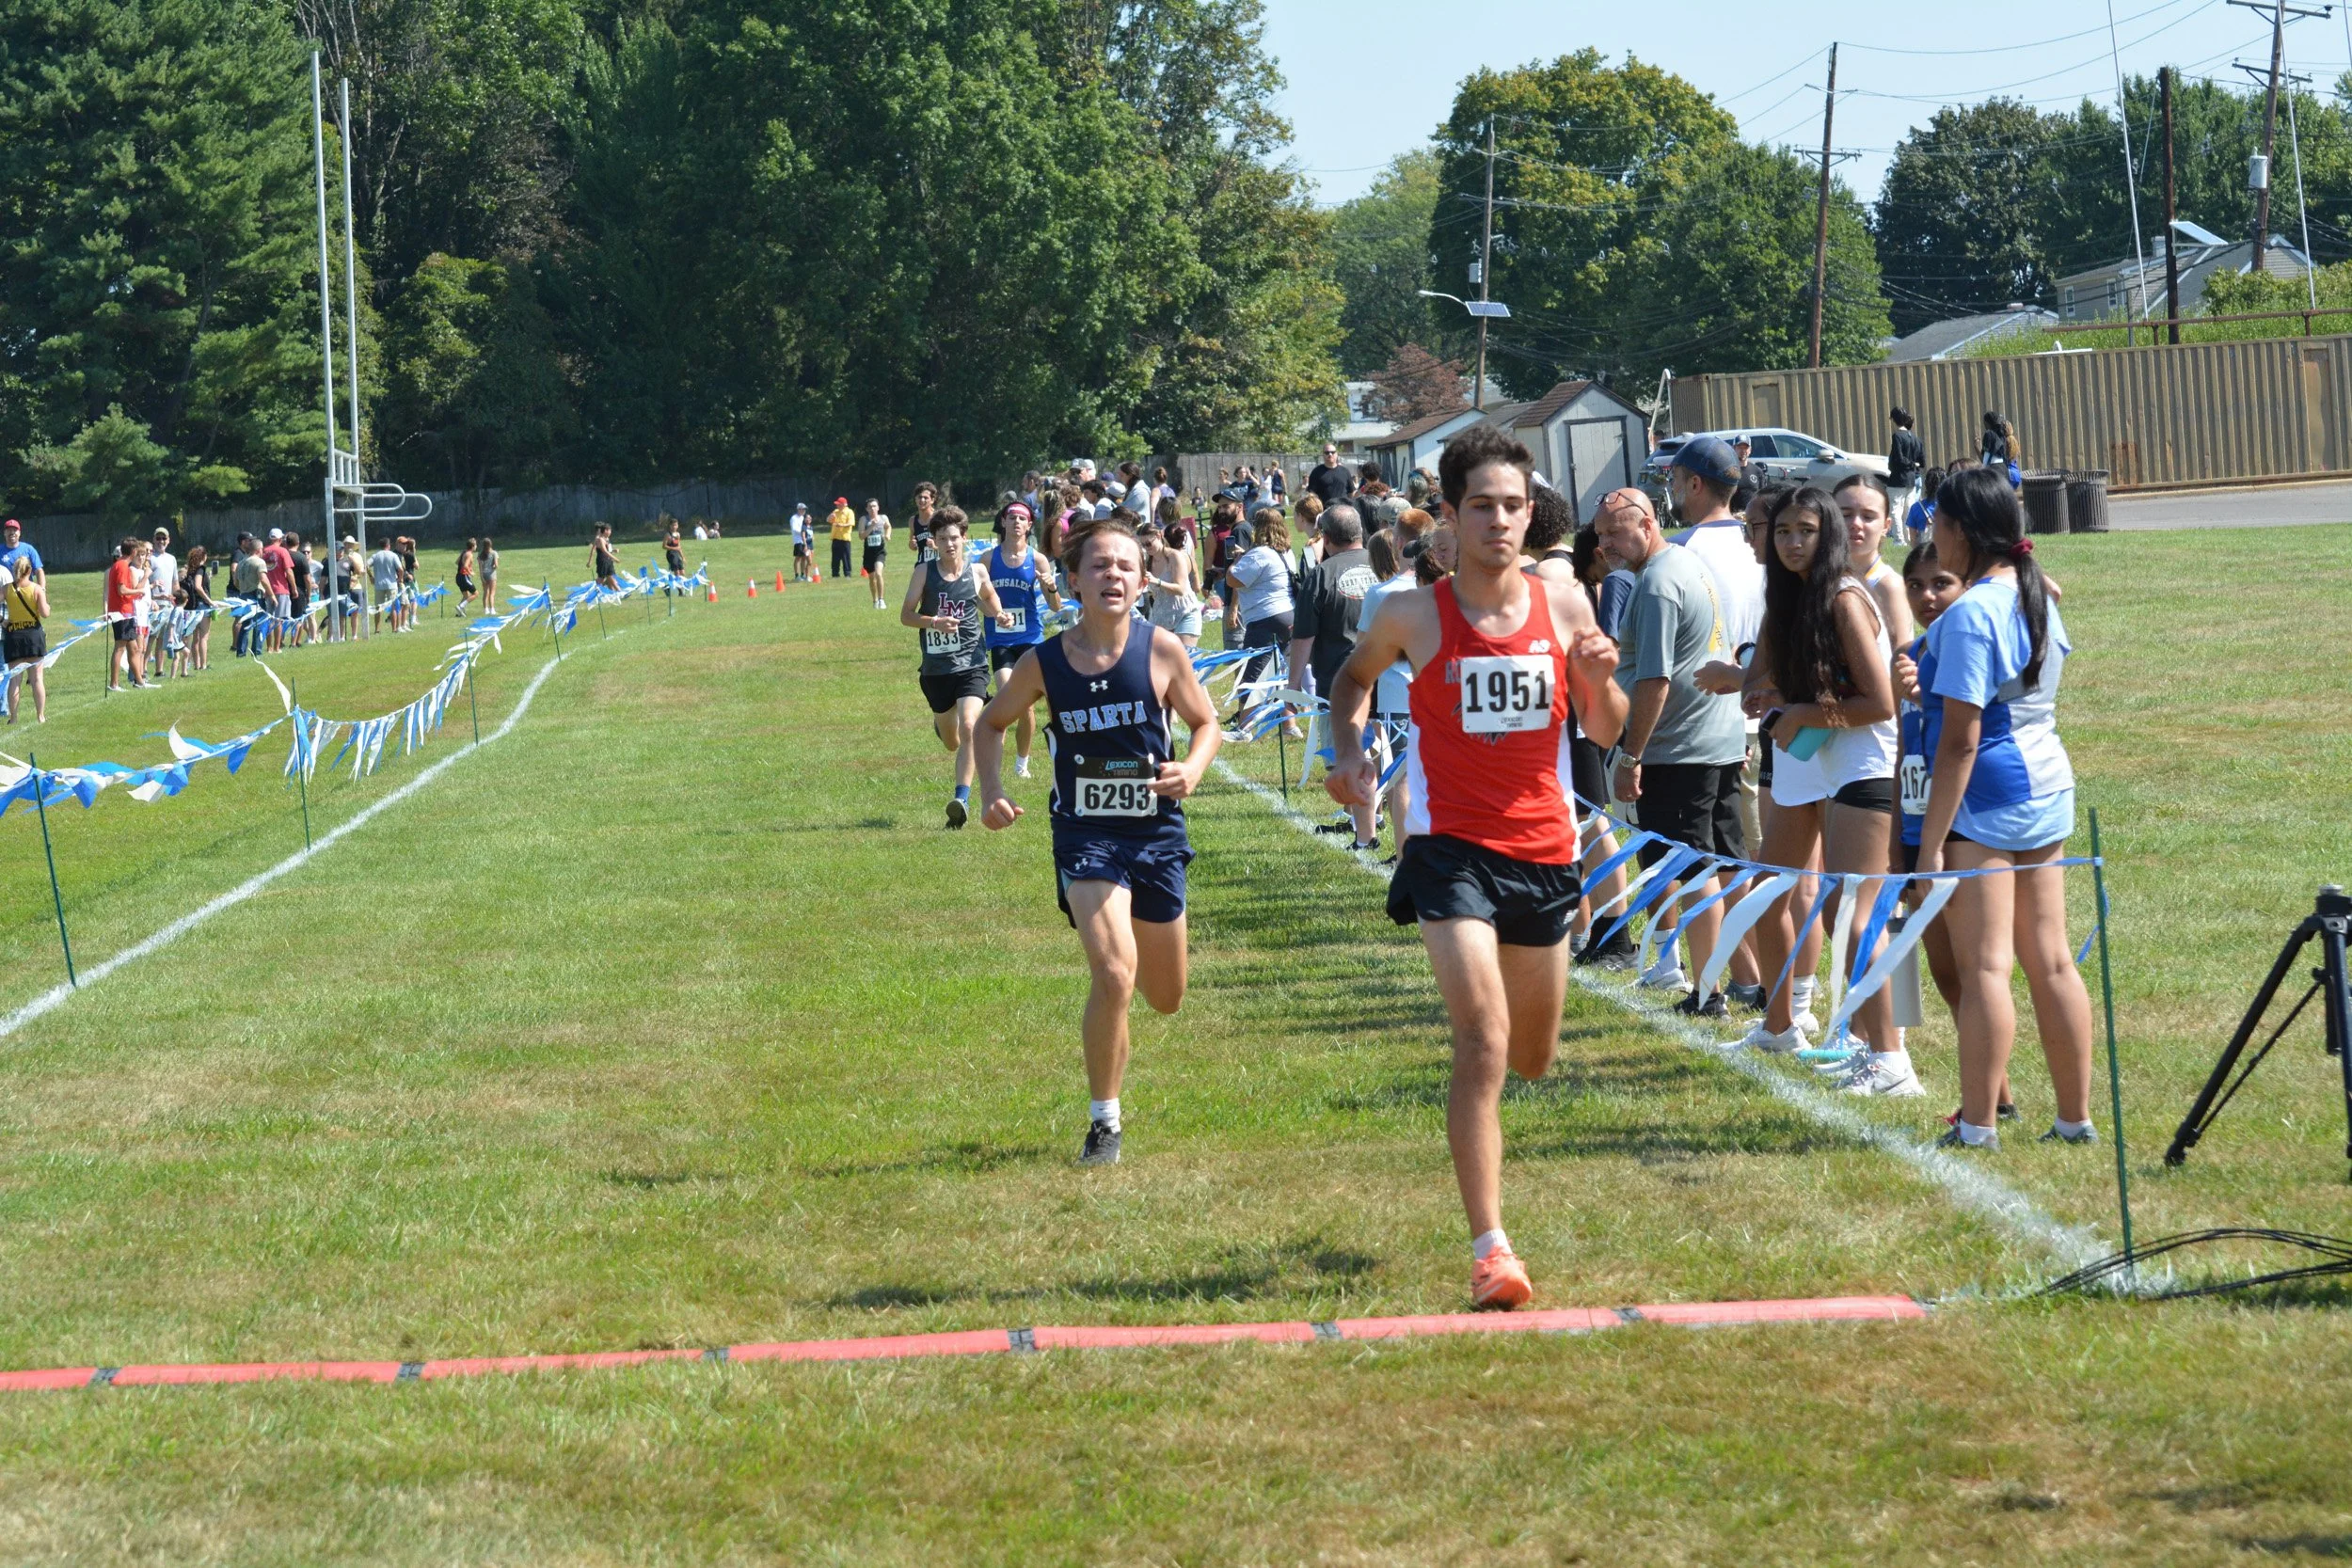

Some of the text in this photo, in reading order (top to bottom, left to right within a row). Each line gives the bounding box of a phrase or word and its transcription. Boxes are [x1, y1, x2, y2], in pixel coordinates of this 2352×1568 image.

[927, 631, 959, 647] 1833
[1465, 670, 1550, 713] 1951
[1059, 701, 1148, 734] SPARTA
[1084, 783, 1151, 810] 6293
